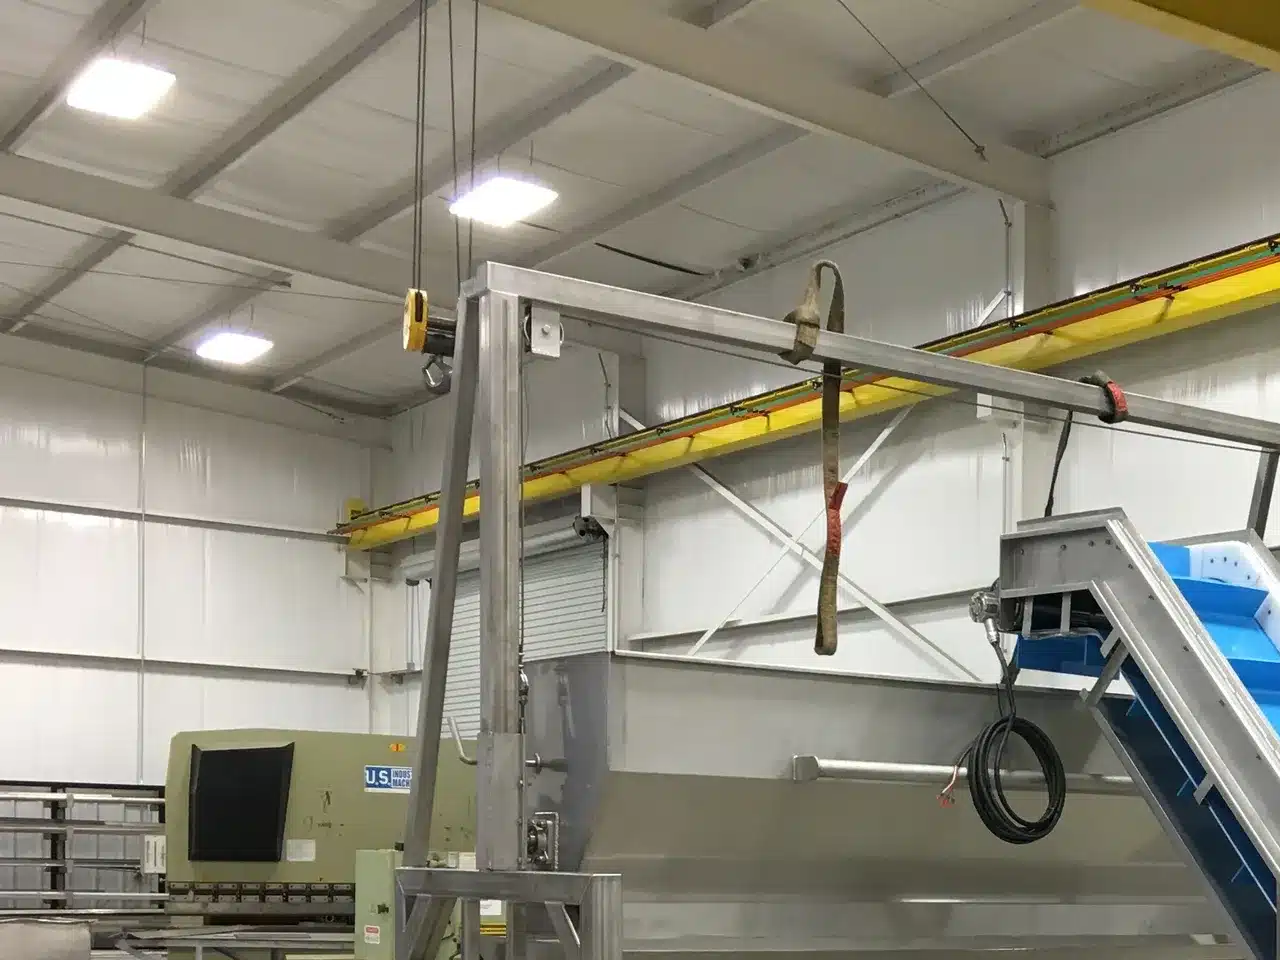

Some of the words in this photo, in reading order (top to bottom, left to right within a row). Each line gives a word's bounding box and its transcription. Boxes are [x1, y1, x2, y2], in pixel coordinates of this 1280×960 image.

[366, 769, 391, 785] U.S.
[392, 770, 411, 779] INDUS
[392, 779, 410, 787] MACH
